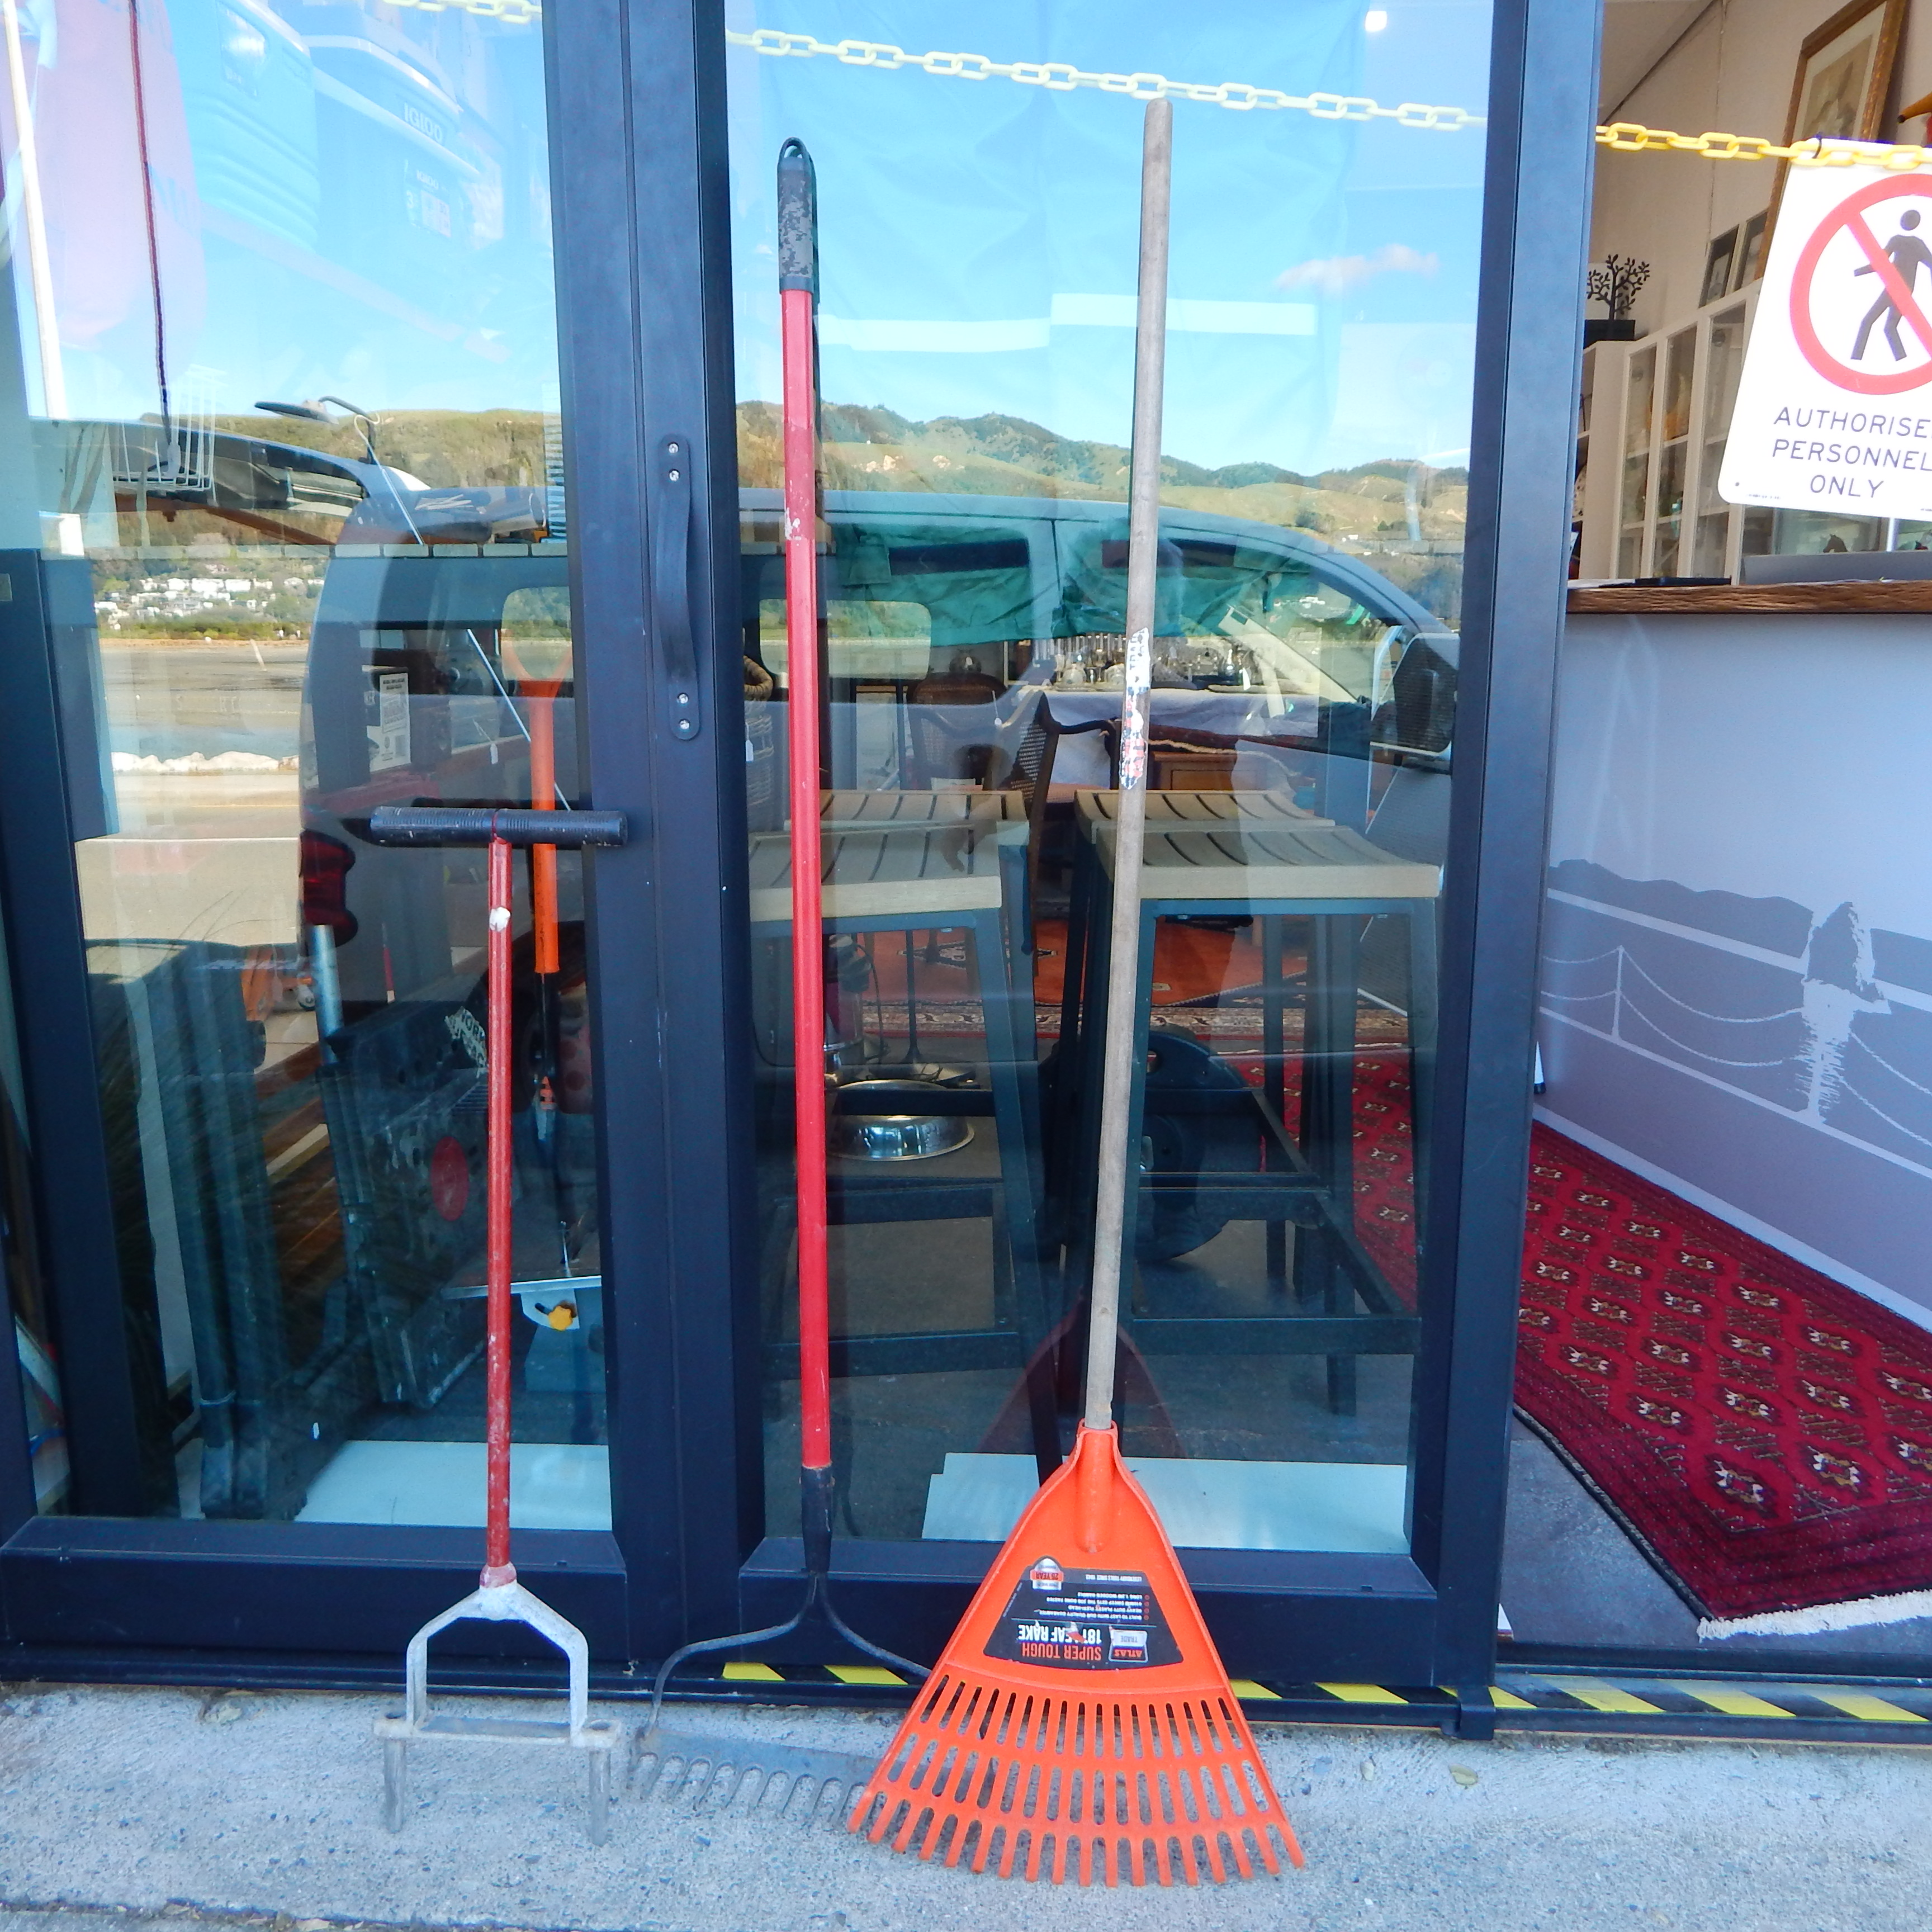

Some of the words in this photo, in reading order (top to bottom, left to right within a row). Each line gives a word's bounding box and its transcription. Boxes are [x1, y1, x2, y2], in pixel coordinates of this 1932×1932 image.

[1773, 406, 1932, 439] AUTHORISE
[1772, 439, 1932, 472] PERSONNEL
[1810, 474, 1884, 498] ONLY
[1018, 1625, 1049, 1641] RAKE
[1050, 1626, 1078, 1644] EAF
[1022, 1642, 1060, 1659] TOUGH
[1064, 1644, 1101, 1661] SUPER
[1114, 1649, 1143, 1658] ATLAS
